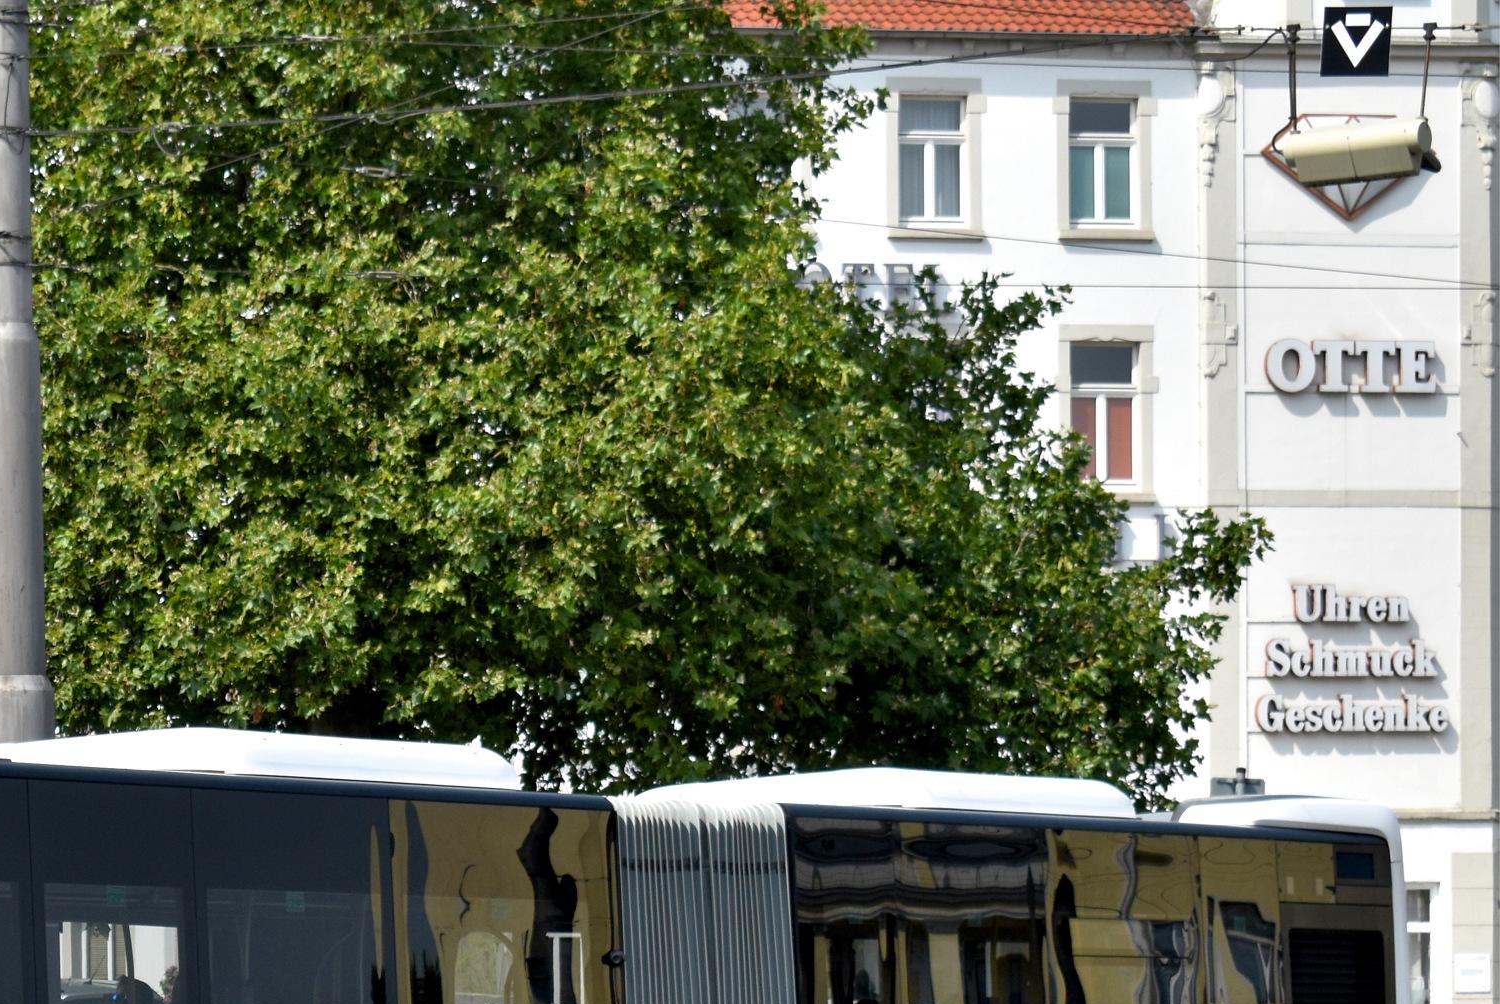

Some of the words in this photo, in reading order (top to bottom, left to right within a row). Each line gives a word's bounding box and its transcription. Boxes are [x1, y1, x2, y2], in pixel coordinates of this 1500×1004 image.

[1264, 338, 1437, 393] OTTE
[1291, 583, 1411, 623] Uhren
[1266, 638, 1438, 678] Schmuck
[1255, 693, 1450, 733] Geschenke
